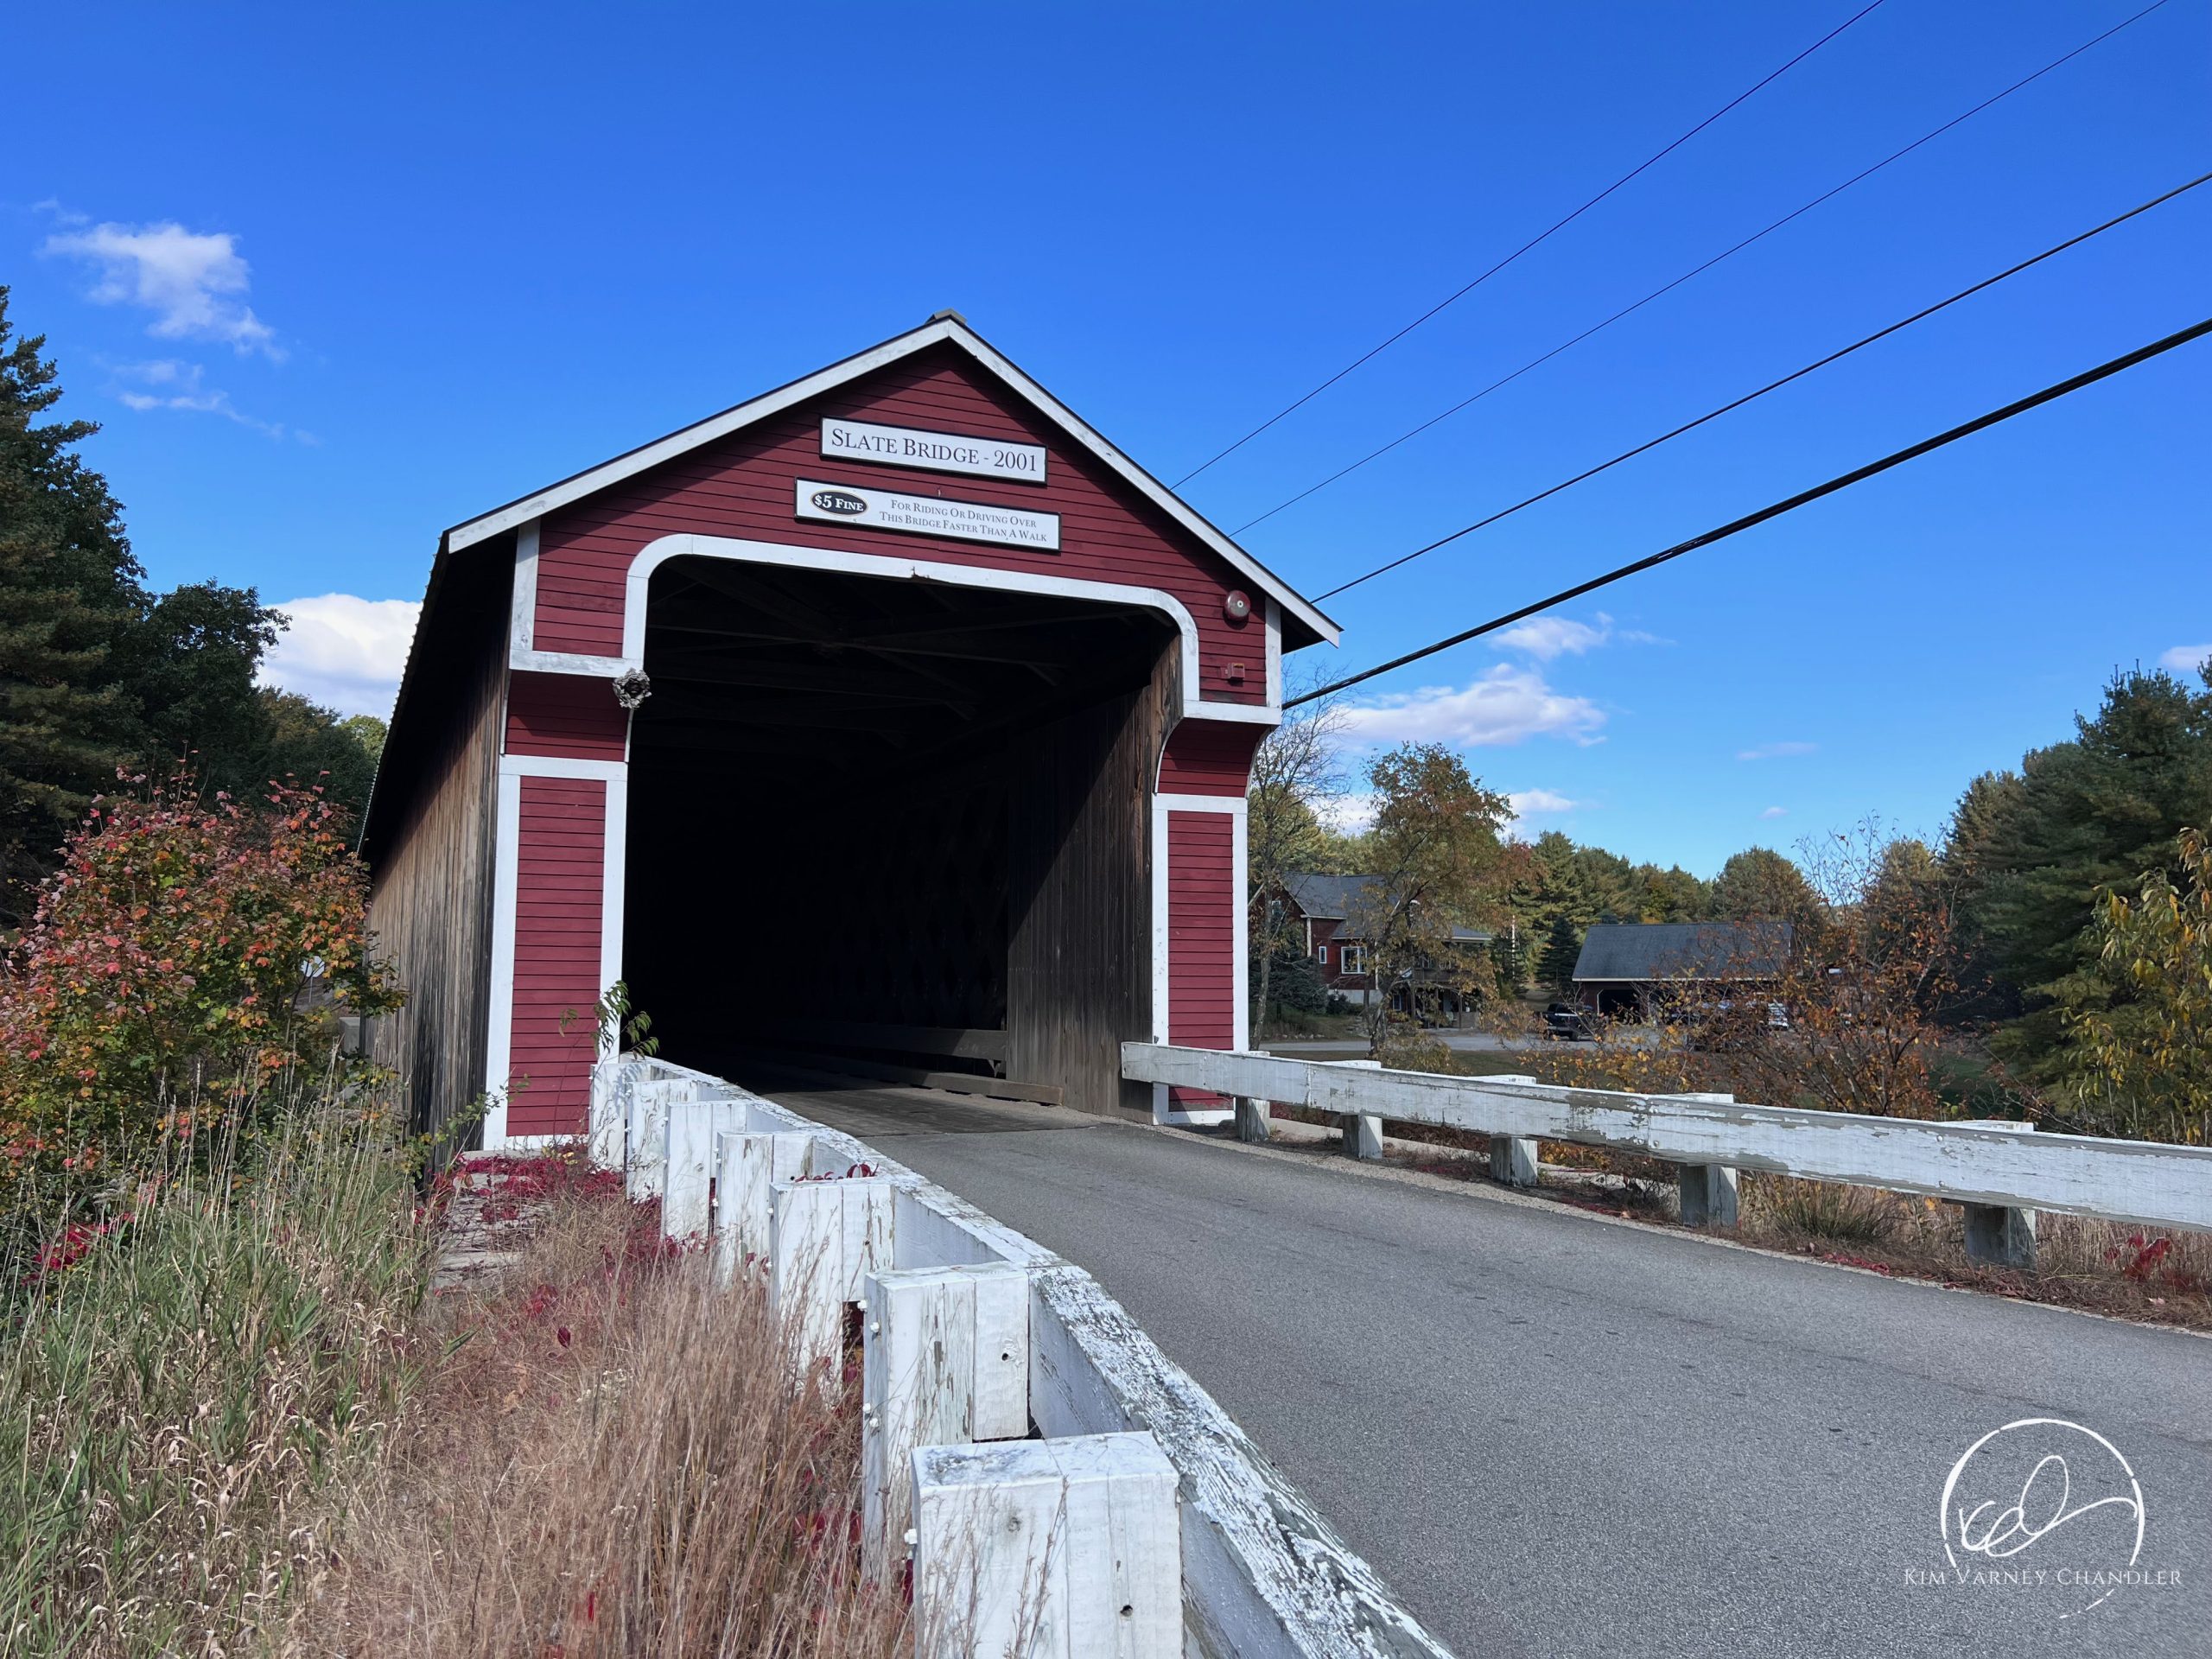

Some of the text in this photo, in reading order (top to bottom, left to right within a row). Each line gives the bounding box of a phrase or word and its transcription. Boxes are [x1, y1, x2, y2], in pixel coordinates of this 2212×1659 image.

[831, 429, 898, 454] SLATE
[903, 438, 979, 465] BRIDGE
[994, 450, 1037, 472] 2001
[814, 494, 863, 512] $5 FINE
[891, 500, 1036, 528] FOR RIDING OR DRIVING OVER
[880, 512, 1046, 542] THIS BRIDGE FASTER THAN A WALK
